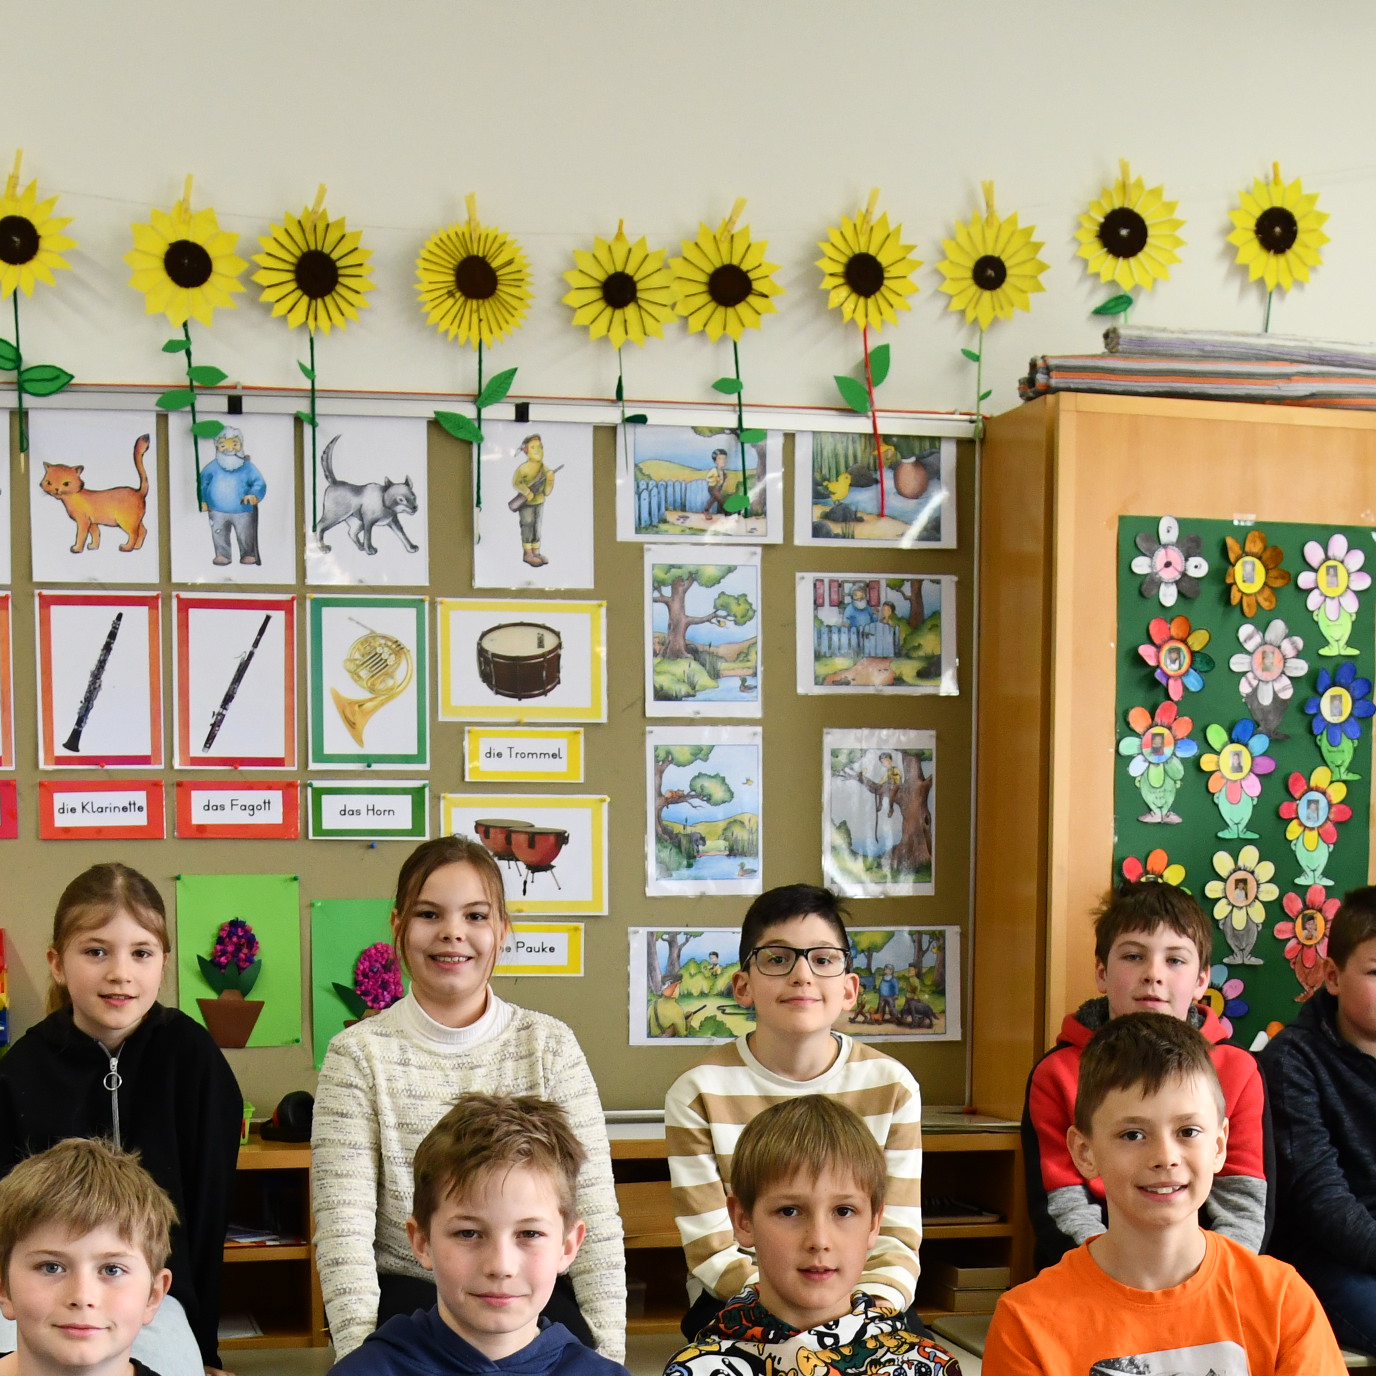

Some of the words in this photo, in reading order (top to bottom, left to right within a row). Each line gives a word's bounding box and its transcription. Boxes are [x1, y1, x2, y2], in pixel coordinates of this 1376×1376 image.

[484, 747, 503, 760] die
[506, 746, 563, 760] Trommel
[57, 802, 78, 815] die
[80, 800, 145, 815] Klarinette
[202, 799, 225, 812] das
[229, 798, 272, 817] Fagott
[338, 803, 362, 817] das
[365, 803, 395, 817] Horn
[515, 940, 556, 954] Pauke
